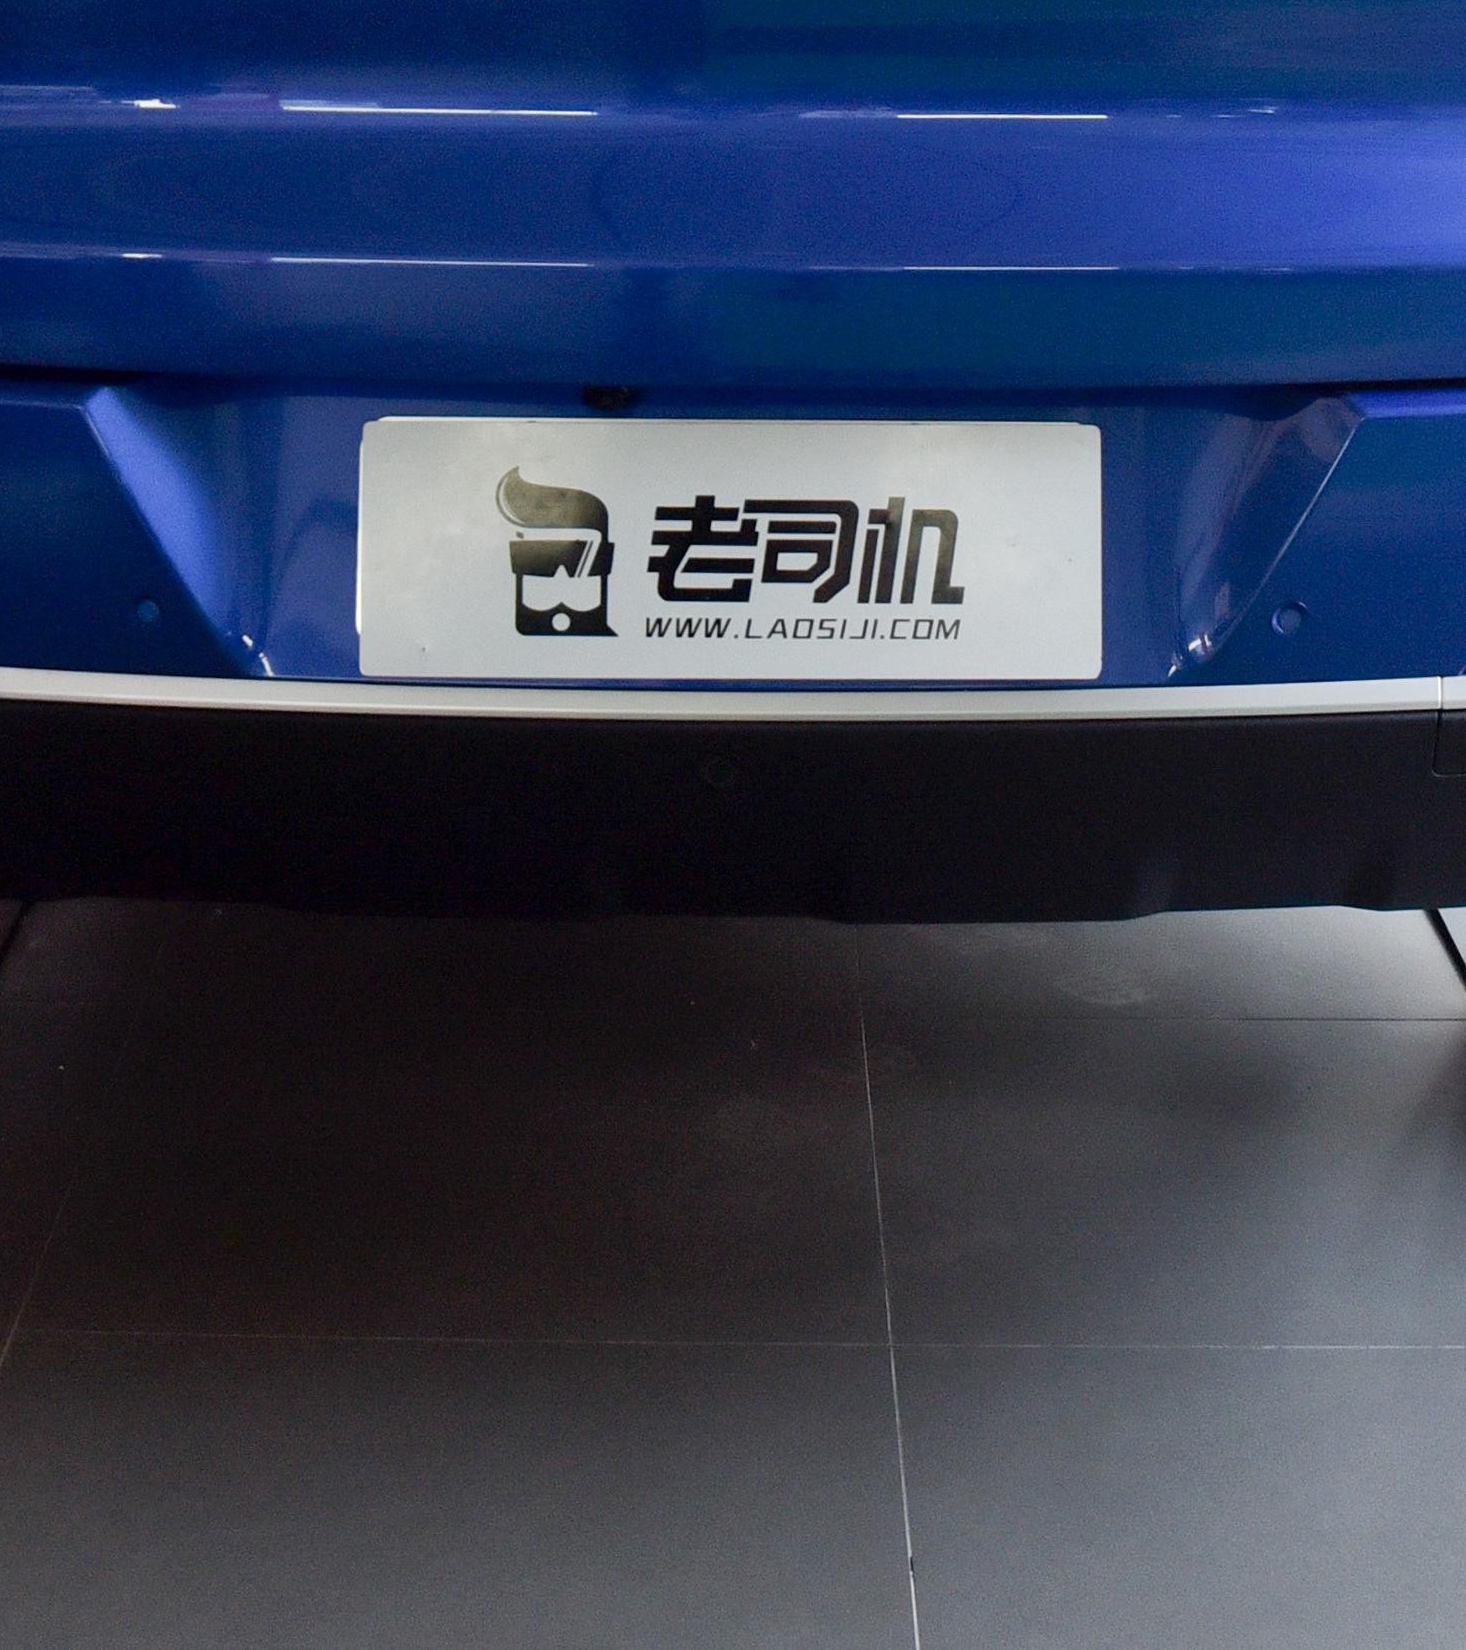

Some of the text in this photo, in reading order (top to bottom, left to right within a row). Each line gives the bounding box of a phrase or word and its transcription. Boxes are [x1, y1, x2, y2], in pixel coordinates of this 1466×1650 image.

[646, 494, 965, 604] 老司机
[644, 617, 961, 641] WWW.LAOSIJI.COM
